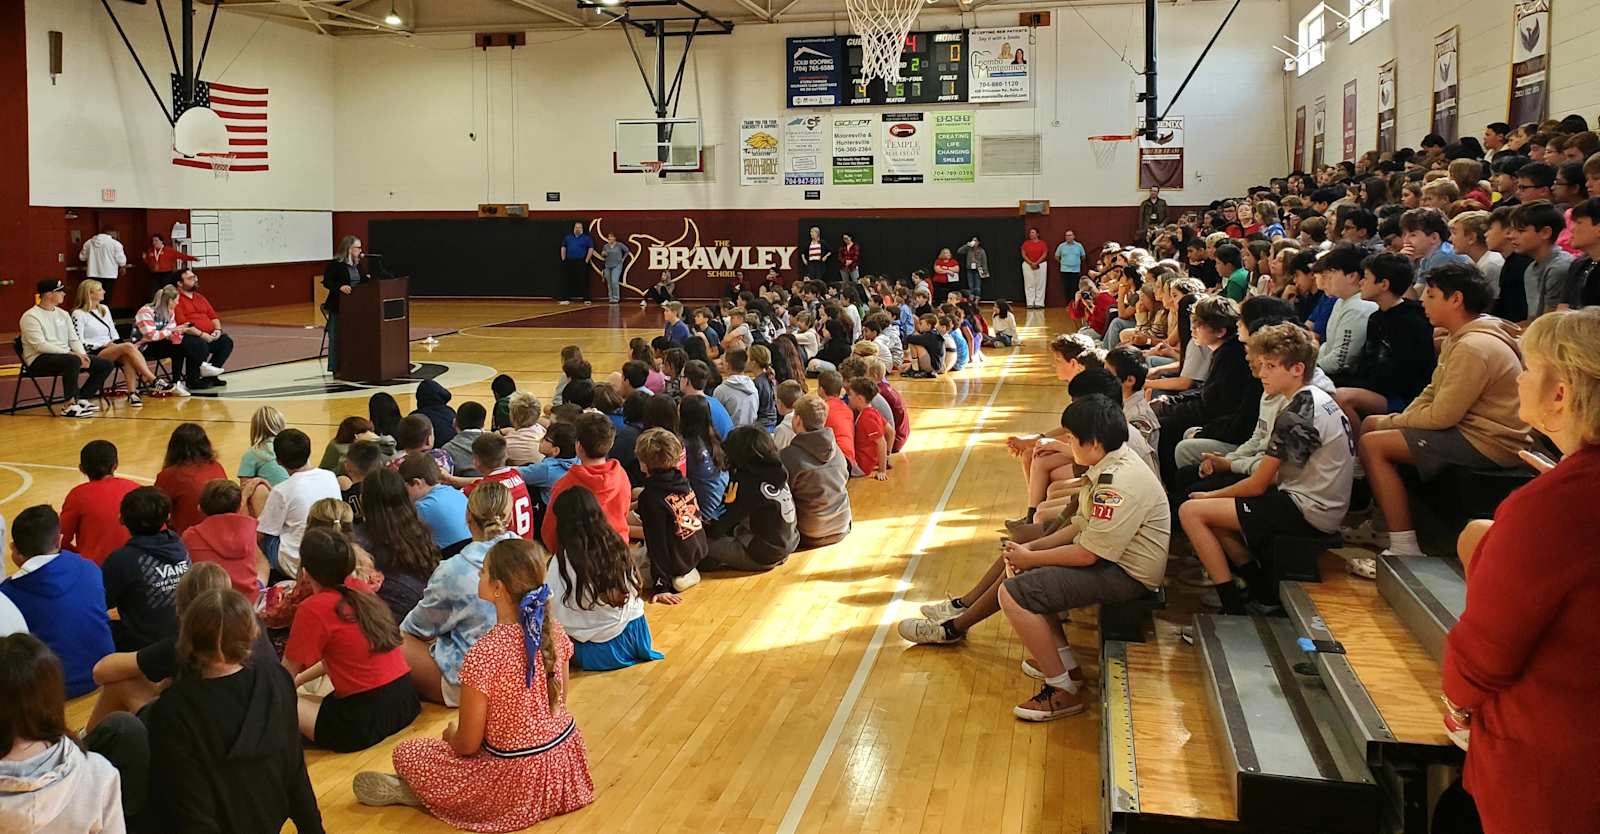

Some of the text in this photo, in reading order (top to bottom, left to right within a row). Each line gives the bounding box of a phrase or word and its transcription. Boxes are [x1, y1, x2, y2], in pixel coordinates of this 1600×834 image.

[935, 34, 962, 42] HOME
[912, 58, 920, 71] 2
[744, 164, 778, 175] FOOTBALL
[648, 246, 798, 270] BRAWLEY
[515, 496, 530, 536] 6
[1092, 506, 1111, 518] 171
[155, 560, 189, 578] VANS
